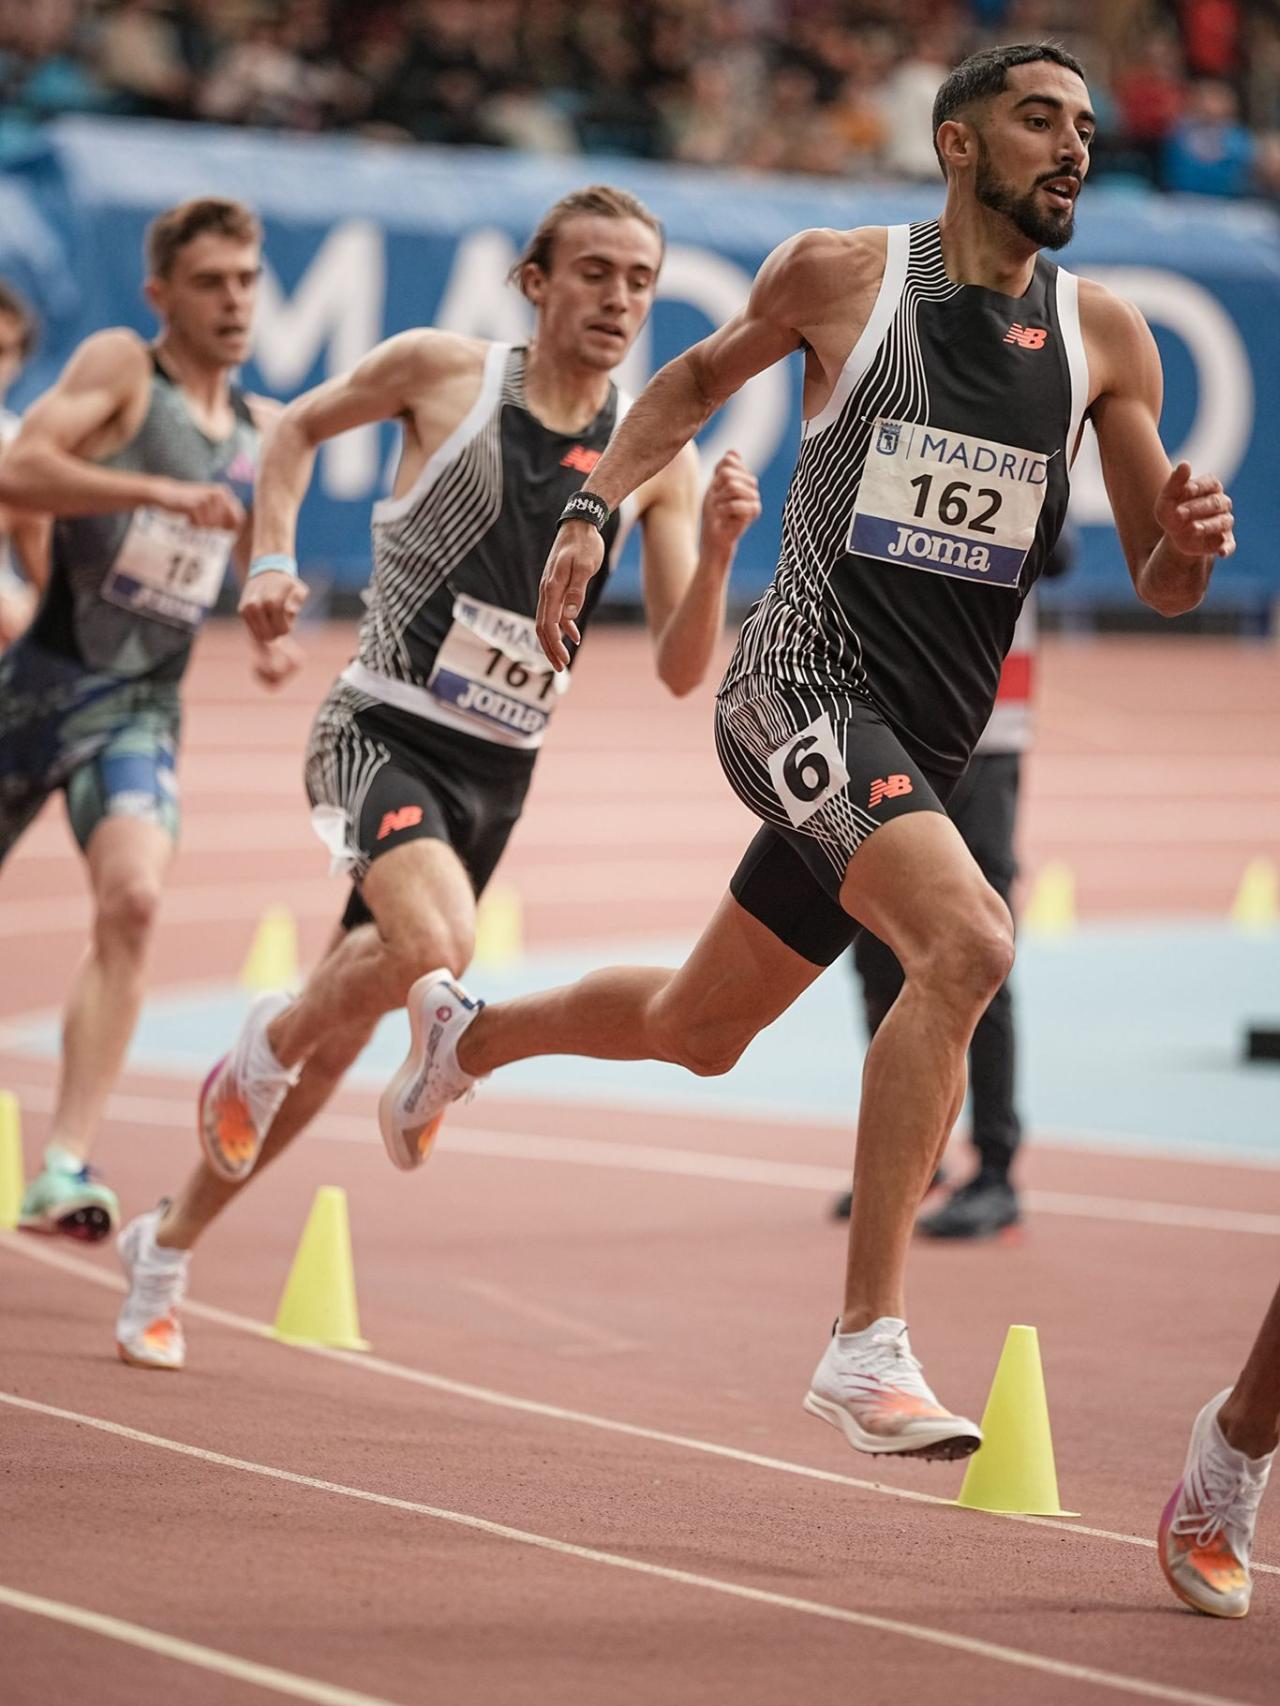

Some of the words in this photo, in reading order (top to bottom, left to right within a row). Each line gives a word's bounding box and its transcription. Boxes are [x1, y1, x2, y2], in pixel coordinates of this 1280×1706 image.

[919, 433, 1048, 485] MADRID
[910, 473, 1003, 535] 162
[485, 647, 554, 701] 161
[783, 735, 830, 802] 6
